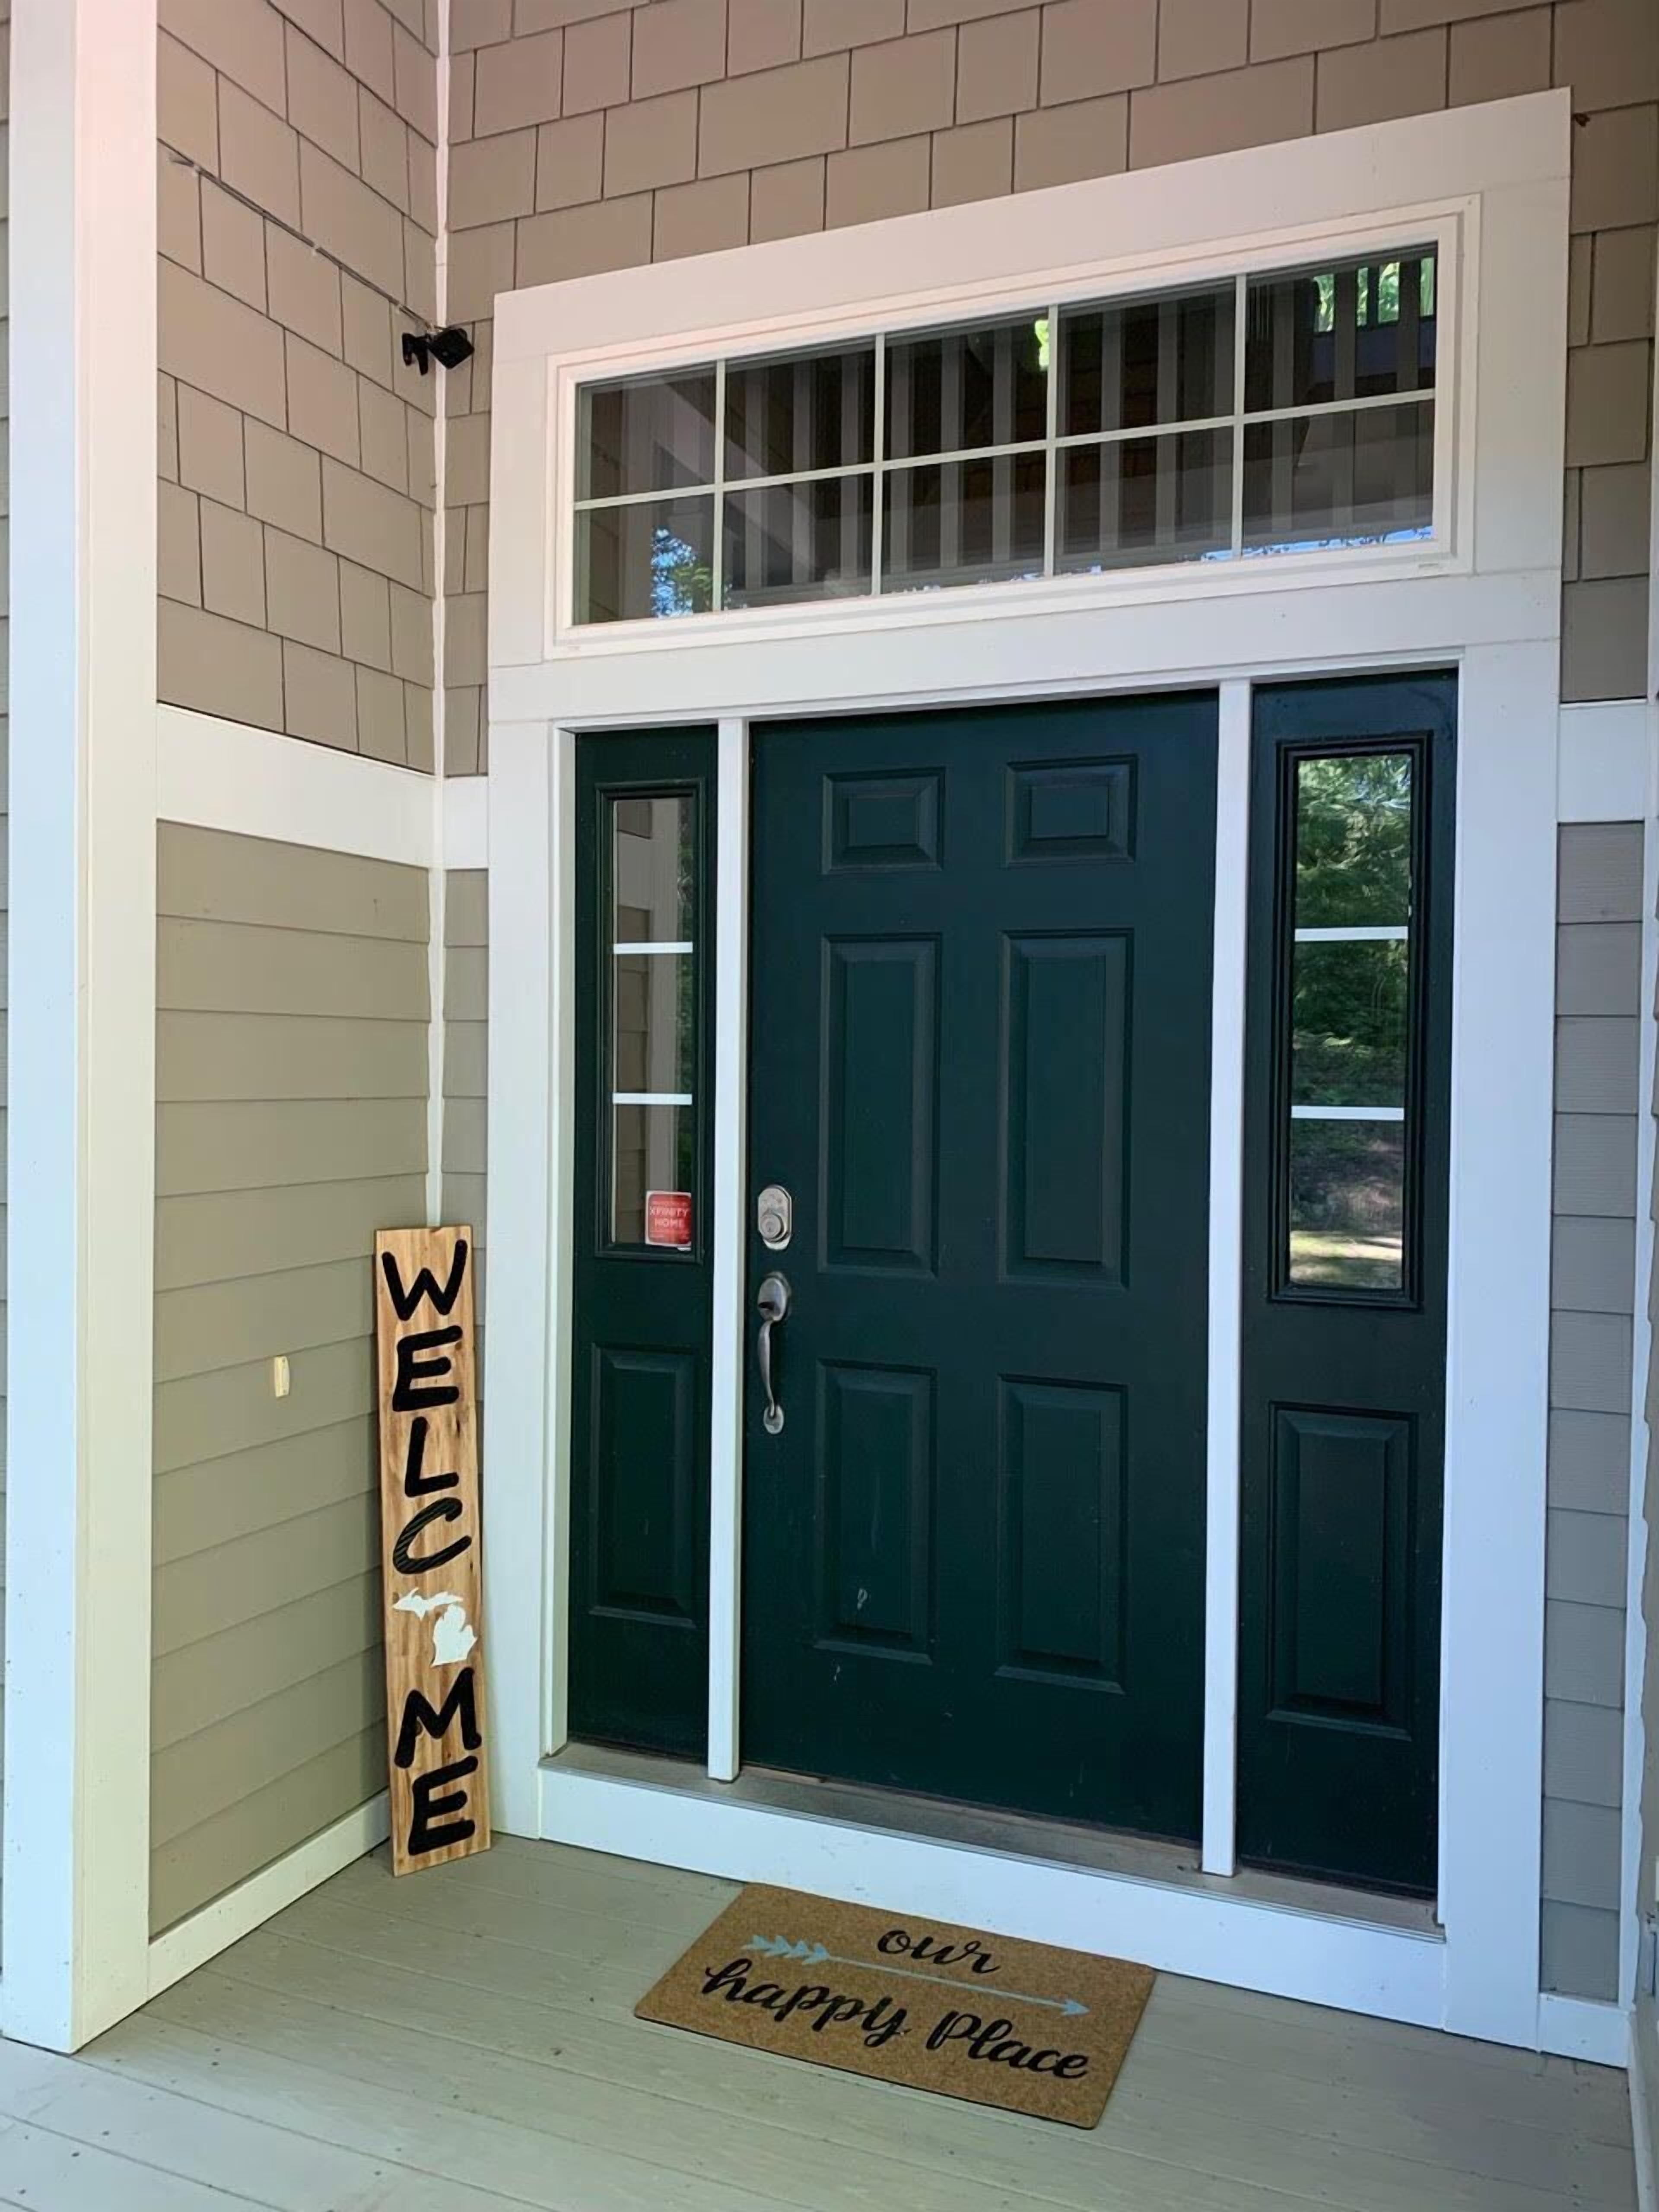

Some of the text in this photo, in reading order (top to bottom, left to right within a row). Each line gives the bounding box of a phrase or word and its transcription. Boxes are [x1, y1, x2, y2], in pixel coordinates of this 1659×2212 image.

[655, 1218, 685, 1227] HOME
[382, 1239, 482, 1857] WELCME
[877, 1929, 1001, 1974] our
[702, 1958, 912, 2048] happy
